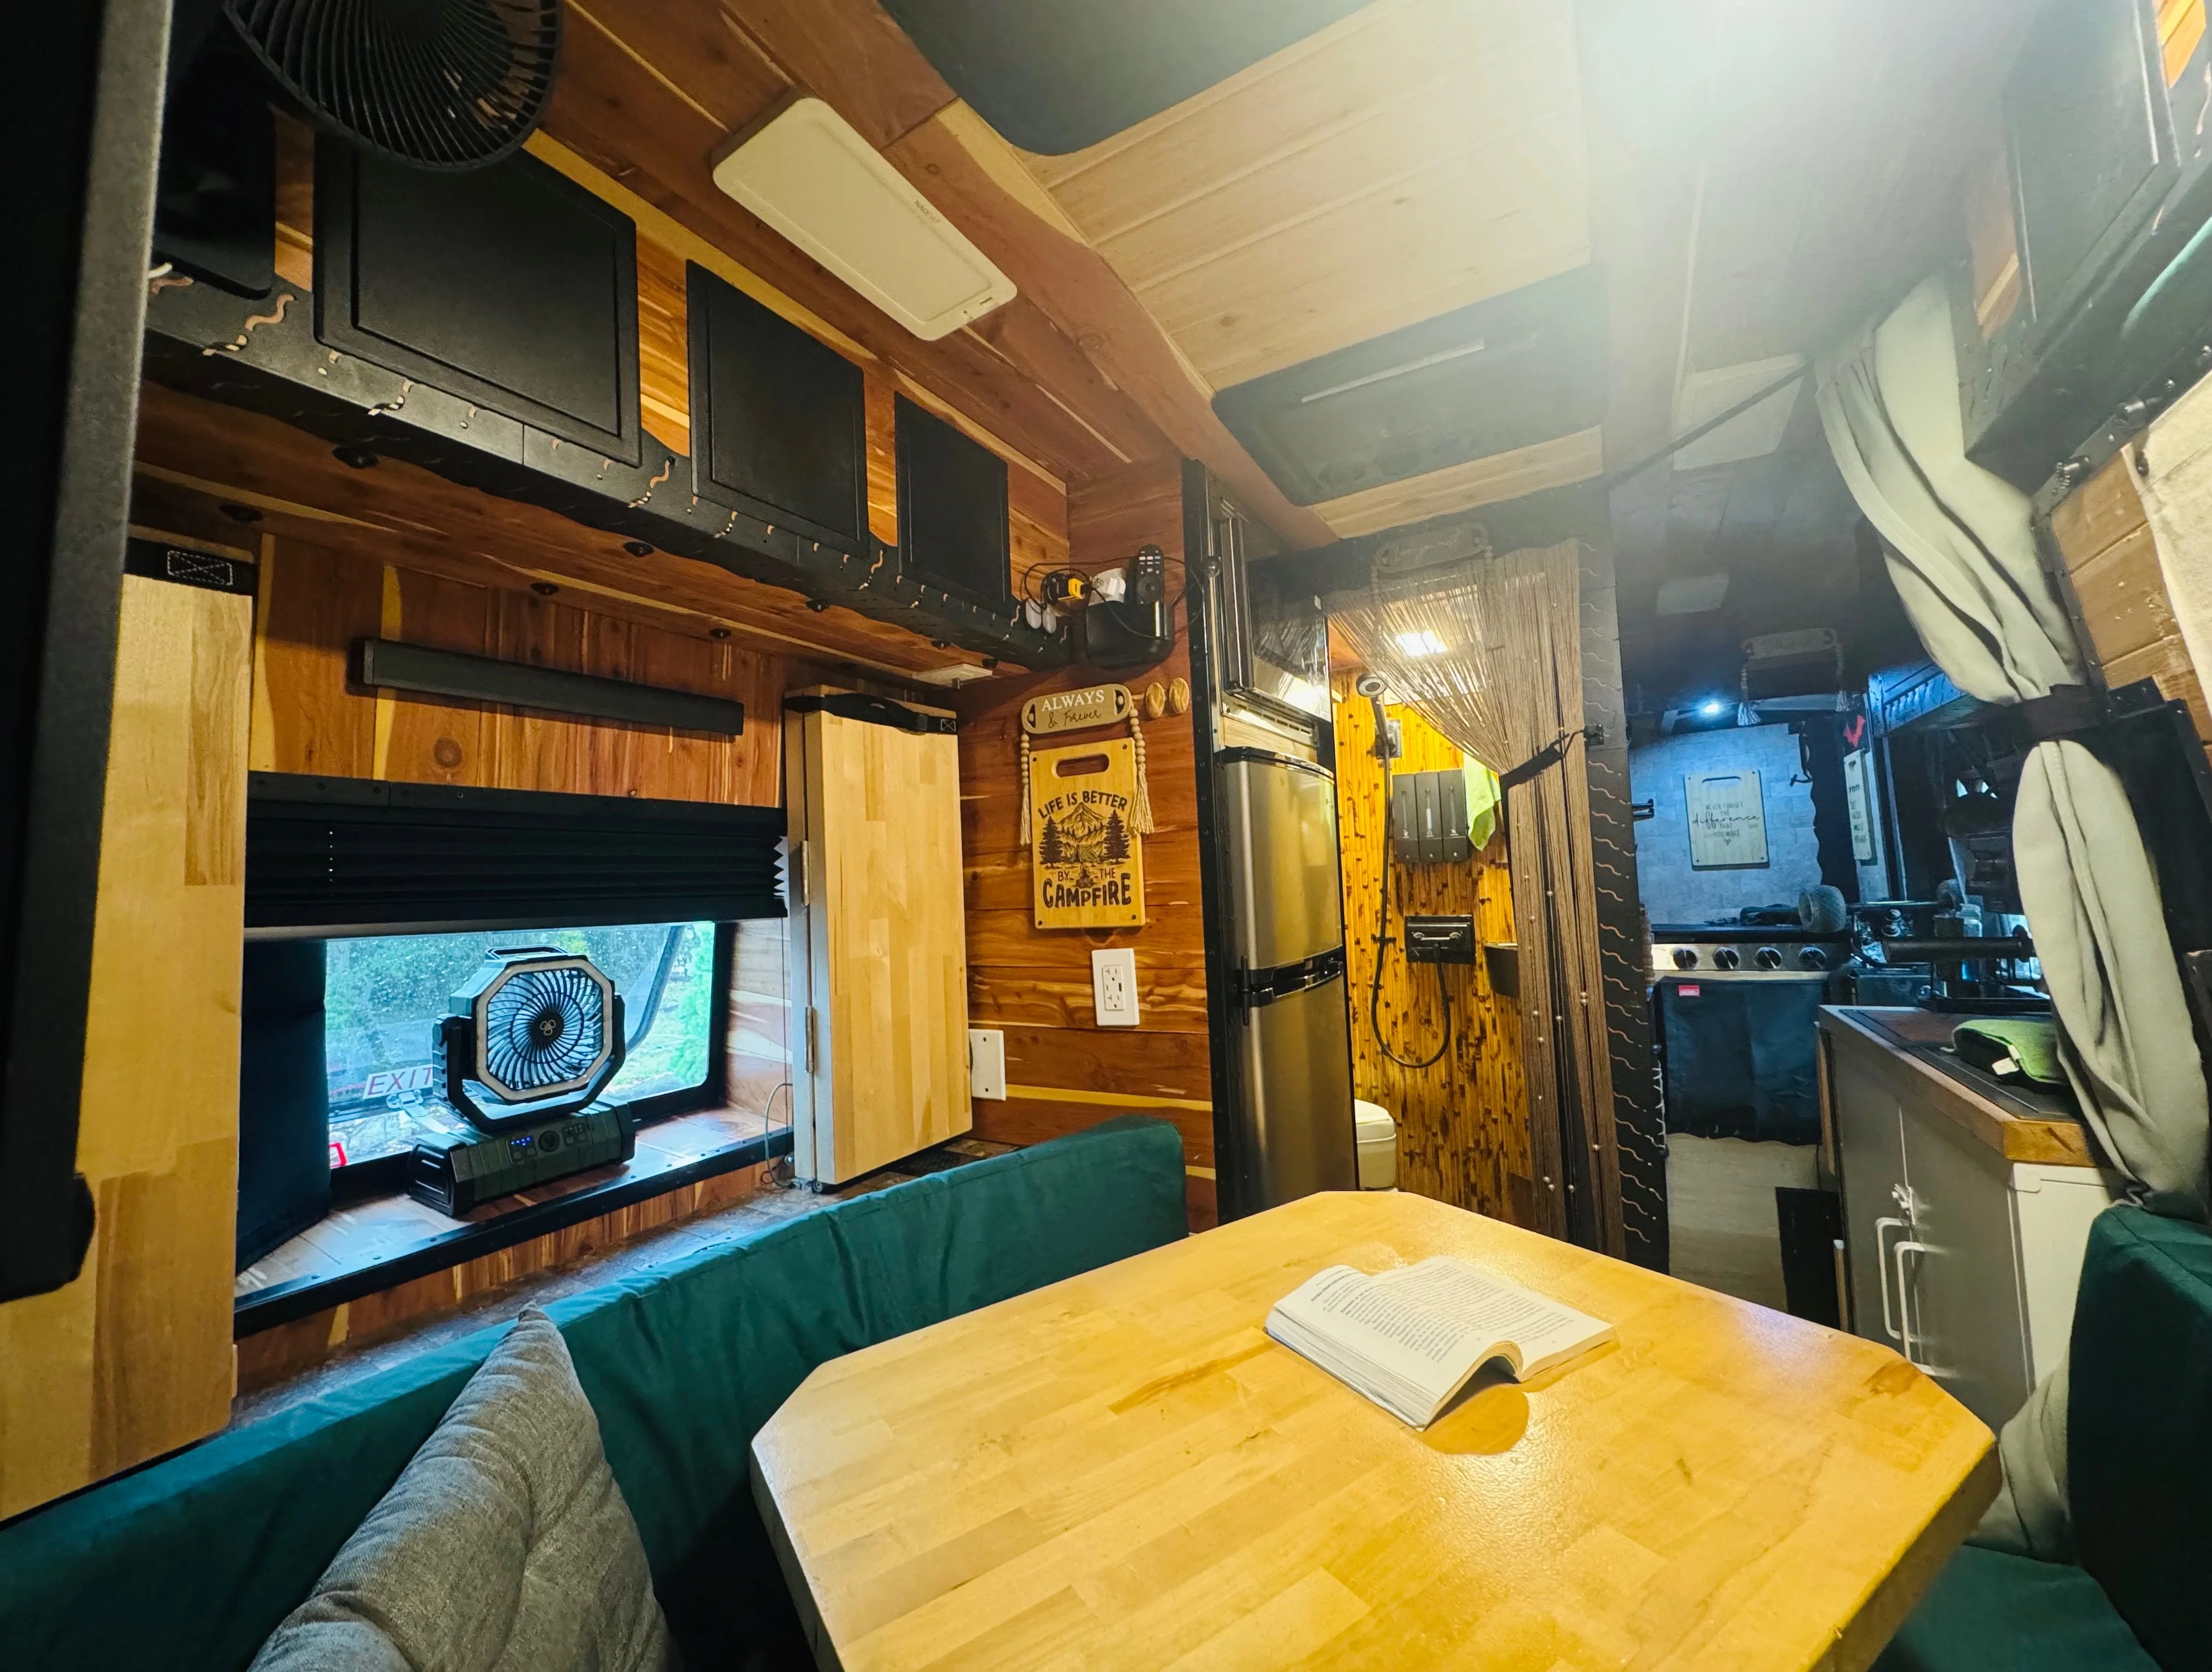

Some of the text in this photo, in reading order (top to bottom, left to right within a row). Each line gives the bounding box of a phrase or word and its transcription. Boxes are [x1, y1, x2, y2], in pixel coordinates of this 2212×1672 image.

[1041, 689, 1104, 711] ALWAYS
[1048, 710, 1102, 728] & Forever
[1038, 790, 1127, 819] LIFE IS BETTER
[1693, 811, 1760, 830] difference
[1058, 868, 1116, 882] BY THE
[1043, 873, 1132, 908] CAMPFIRE
[368, 1067, 433, 1095] EXIT
